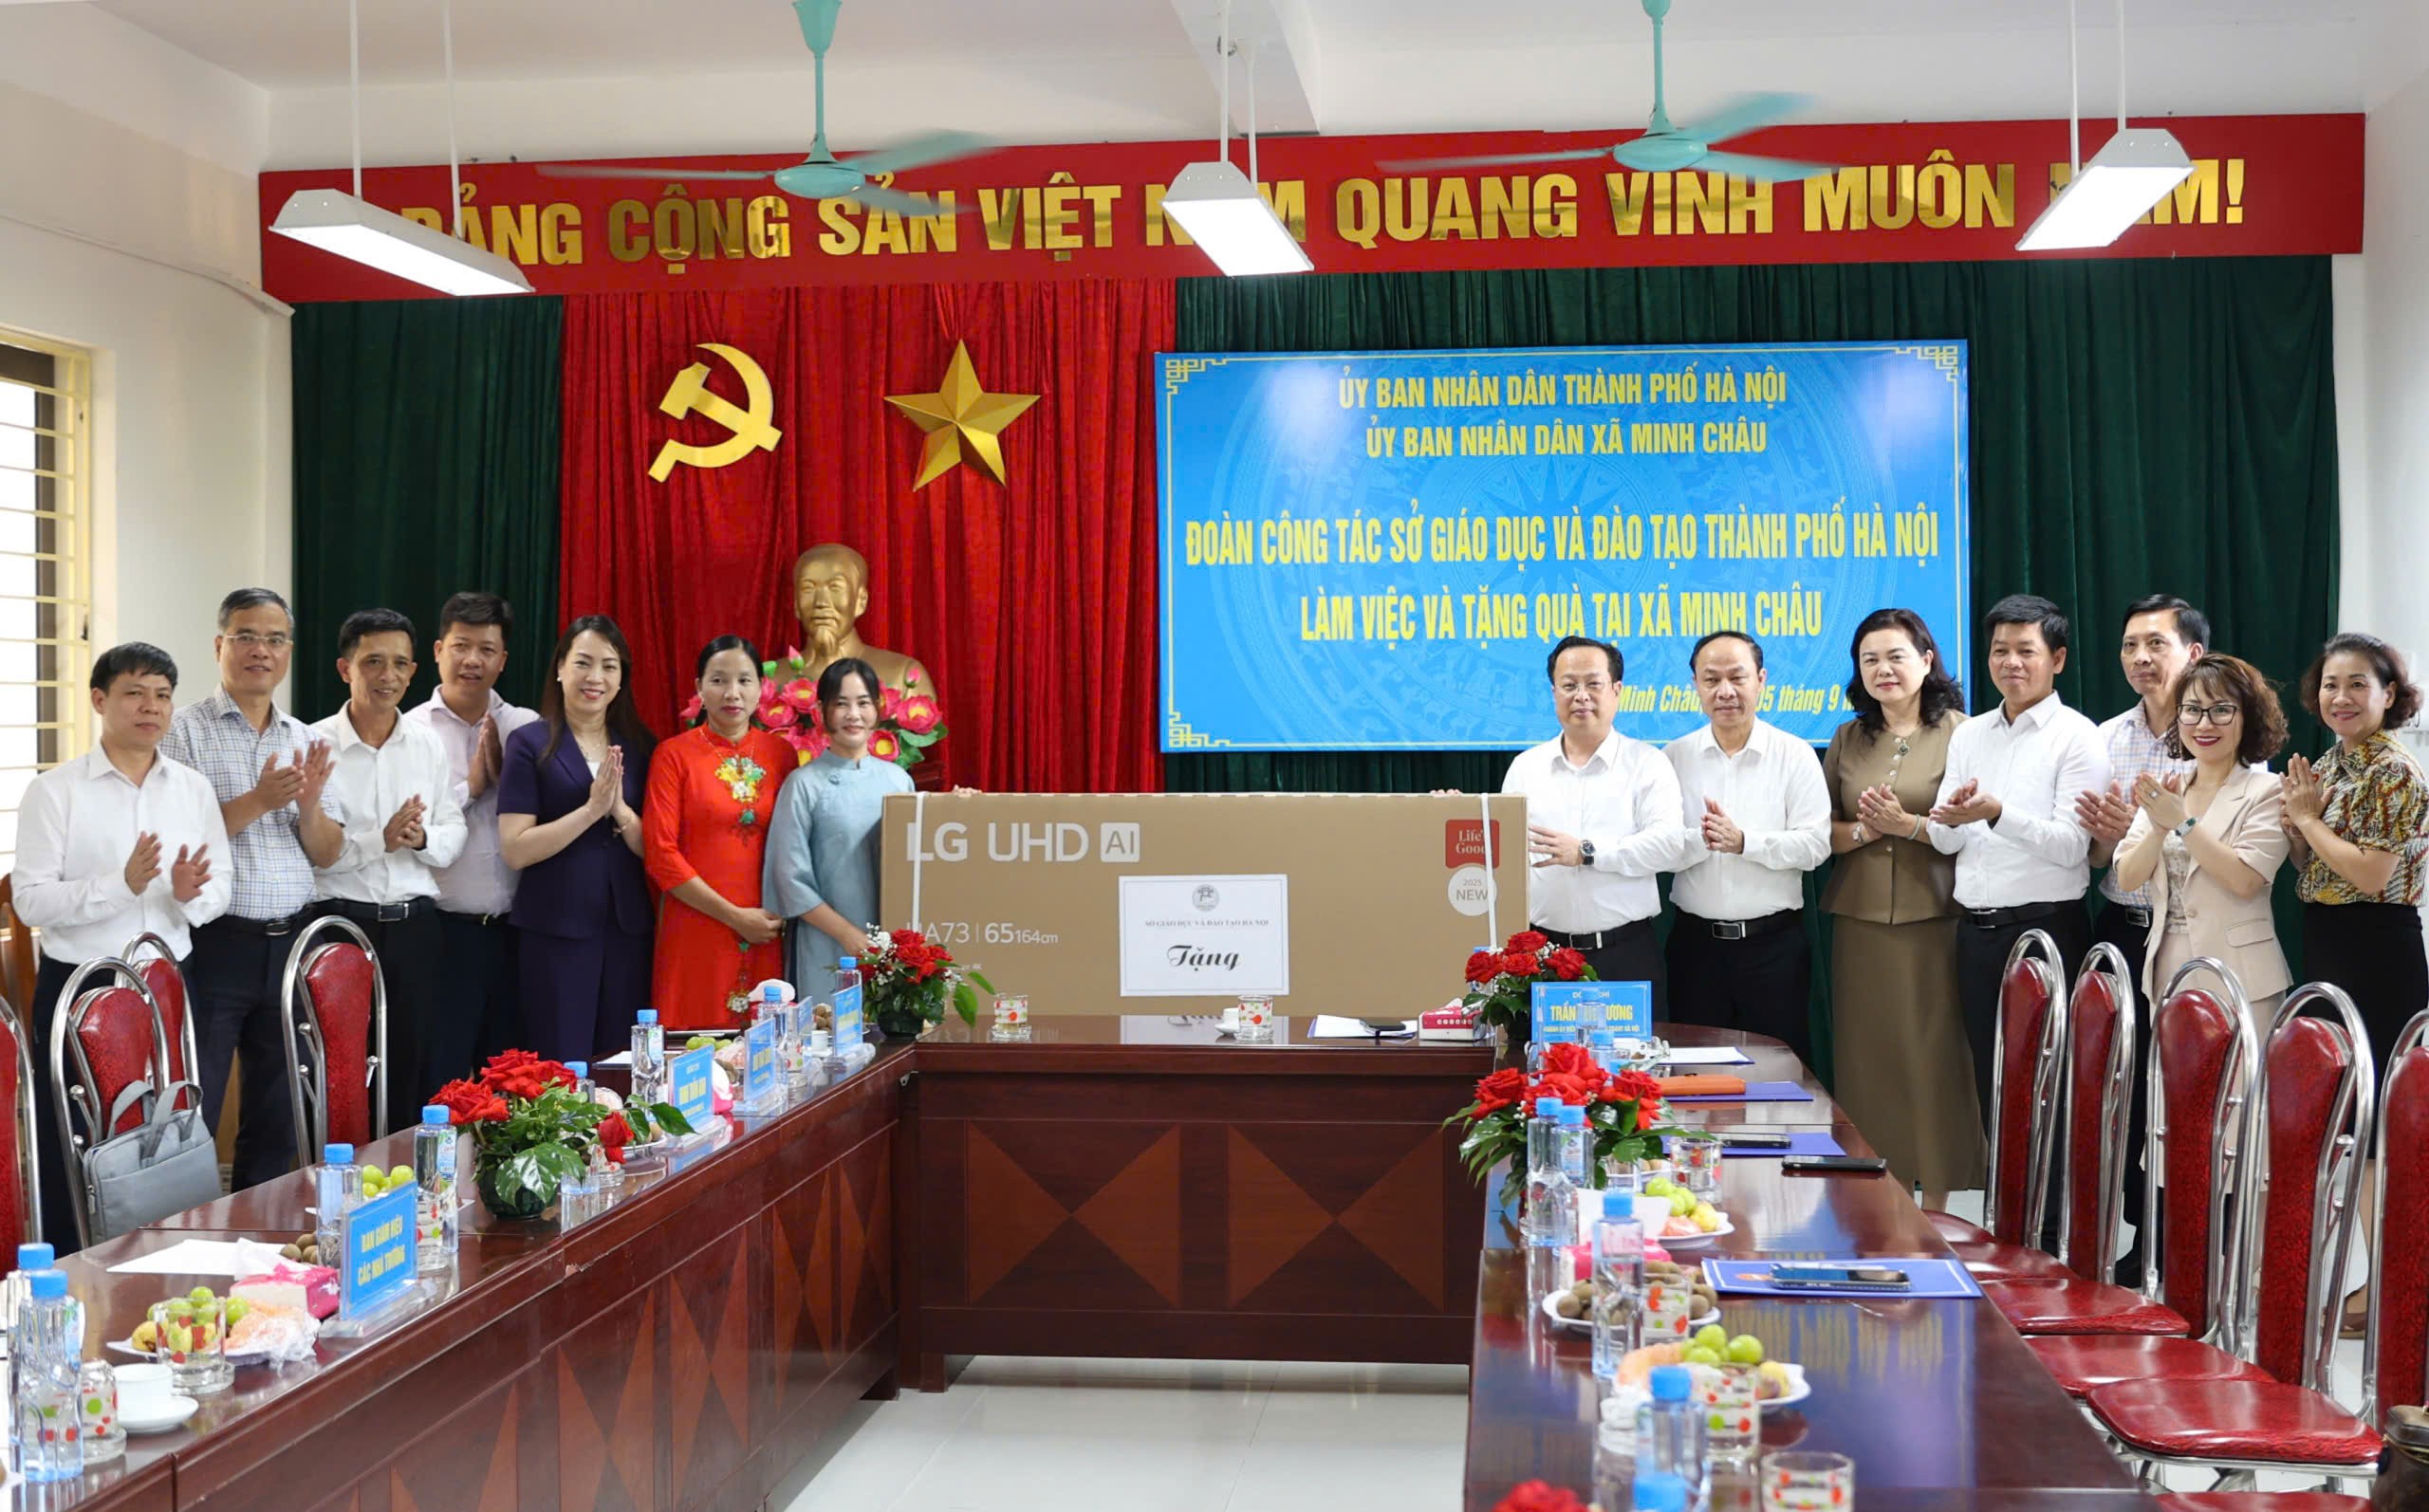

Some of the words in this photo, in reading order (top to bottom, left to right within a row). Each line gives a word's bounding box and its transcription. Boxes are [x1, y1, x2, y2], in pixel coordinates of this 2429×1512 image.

[608, 183, 791, 274] CỘNG
[818, 171, 957, 255] SẢN
[977, 172, 1122, 262] VIỆT
[1145, 180, 1306, 246] NM
[1336, 174, 1577, 249] QUANG
[1606, 172, 1772, 236] VINH
[1803, 149, 2014, 231] MUÔN
[1339, 365, 1369, 409] ỦY
[1377, 378, 1425, 408] BAN
[1433, 370, 1500, 407] NHÂN
[1508, 368, 1556, 406] DÂN
[1564, 366, 1642, 405] THÀNH
[1650, 360, 1699, 403] PHỐ
[1705, 364, 1738, 403] HÀ
[1745, 364, 1787, 410] NỘI
[1366, 415, 1397, 457] ỦY
[1404, 427, 1453, 457] BAN
[1460, 418, 1527, 456] NHÂN
[1535, 417, 1584, 455] DÂN
[1591, 417, 1623, 454] XÃ
[1631, 423, 1696, 453] MINH
[1702, 415, 1768, 452] CHÂU
[1185, 509, 1253, 565] ĐOÀN
[1261, 509, 1328, 564] CÔNG
[1335, 508, 1382, 563] TÁC
[1390, 498, 1425, 562] SỞ
[1431, 507, 1489, 562] GIÁO
[1496, 515, 1546, 572] DỤC
[1552, 505, 1586, 561] VÀ
[1592, 505, 1642, 561] ĐÀO
[1650, 514, 1697, 570] TẠO
[1704, 503, 1787, 559] THÀNH
[1795, 495, 1846, 558] PHỐ
[1853, 502, 1887, 558] HÀ
[1895, 502, 1938, 567] NỘI
[1301, 585, 1353, 641] LÀM
[1361, 585, 1416, 651] VIỆC
[1423, 584, 1456, 639] VÀ
[1462, 584, 1528, 650] TẶNG
[1535, 583, 1585, 644] QUÀ
[1592, 592, 1631, 648] TẠI
[1639, 583, 1673, 637] XÃ
[1680, 592, 1747, 637] MINH
[1754, 581, 1822, 637] CHÂU
[1618, 685, 1657, 712] Minh
[1777, 684, 1825, 715] tháng
[1827, 684, 1841, 711] 9
[907, 822, 968, 861] LG
[989, 822, 1088, 861] UHD
[1106, 831, 1135, 854] AI
[1456, 889, 1489, 901] NEW
[1166, 945, 1242, 971] Tặng
